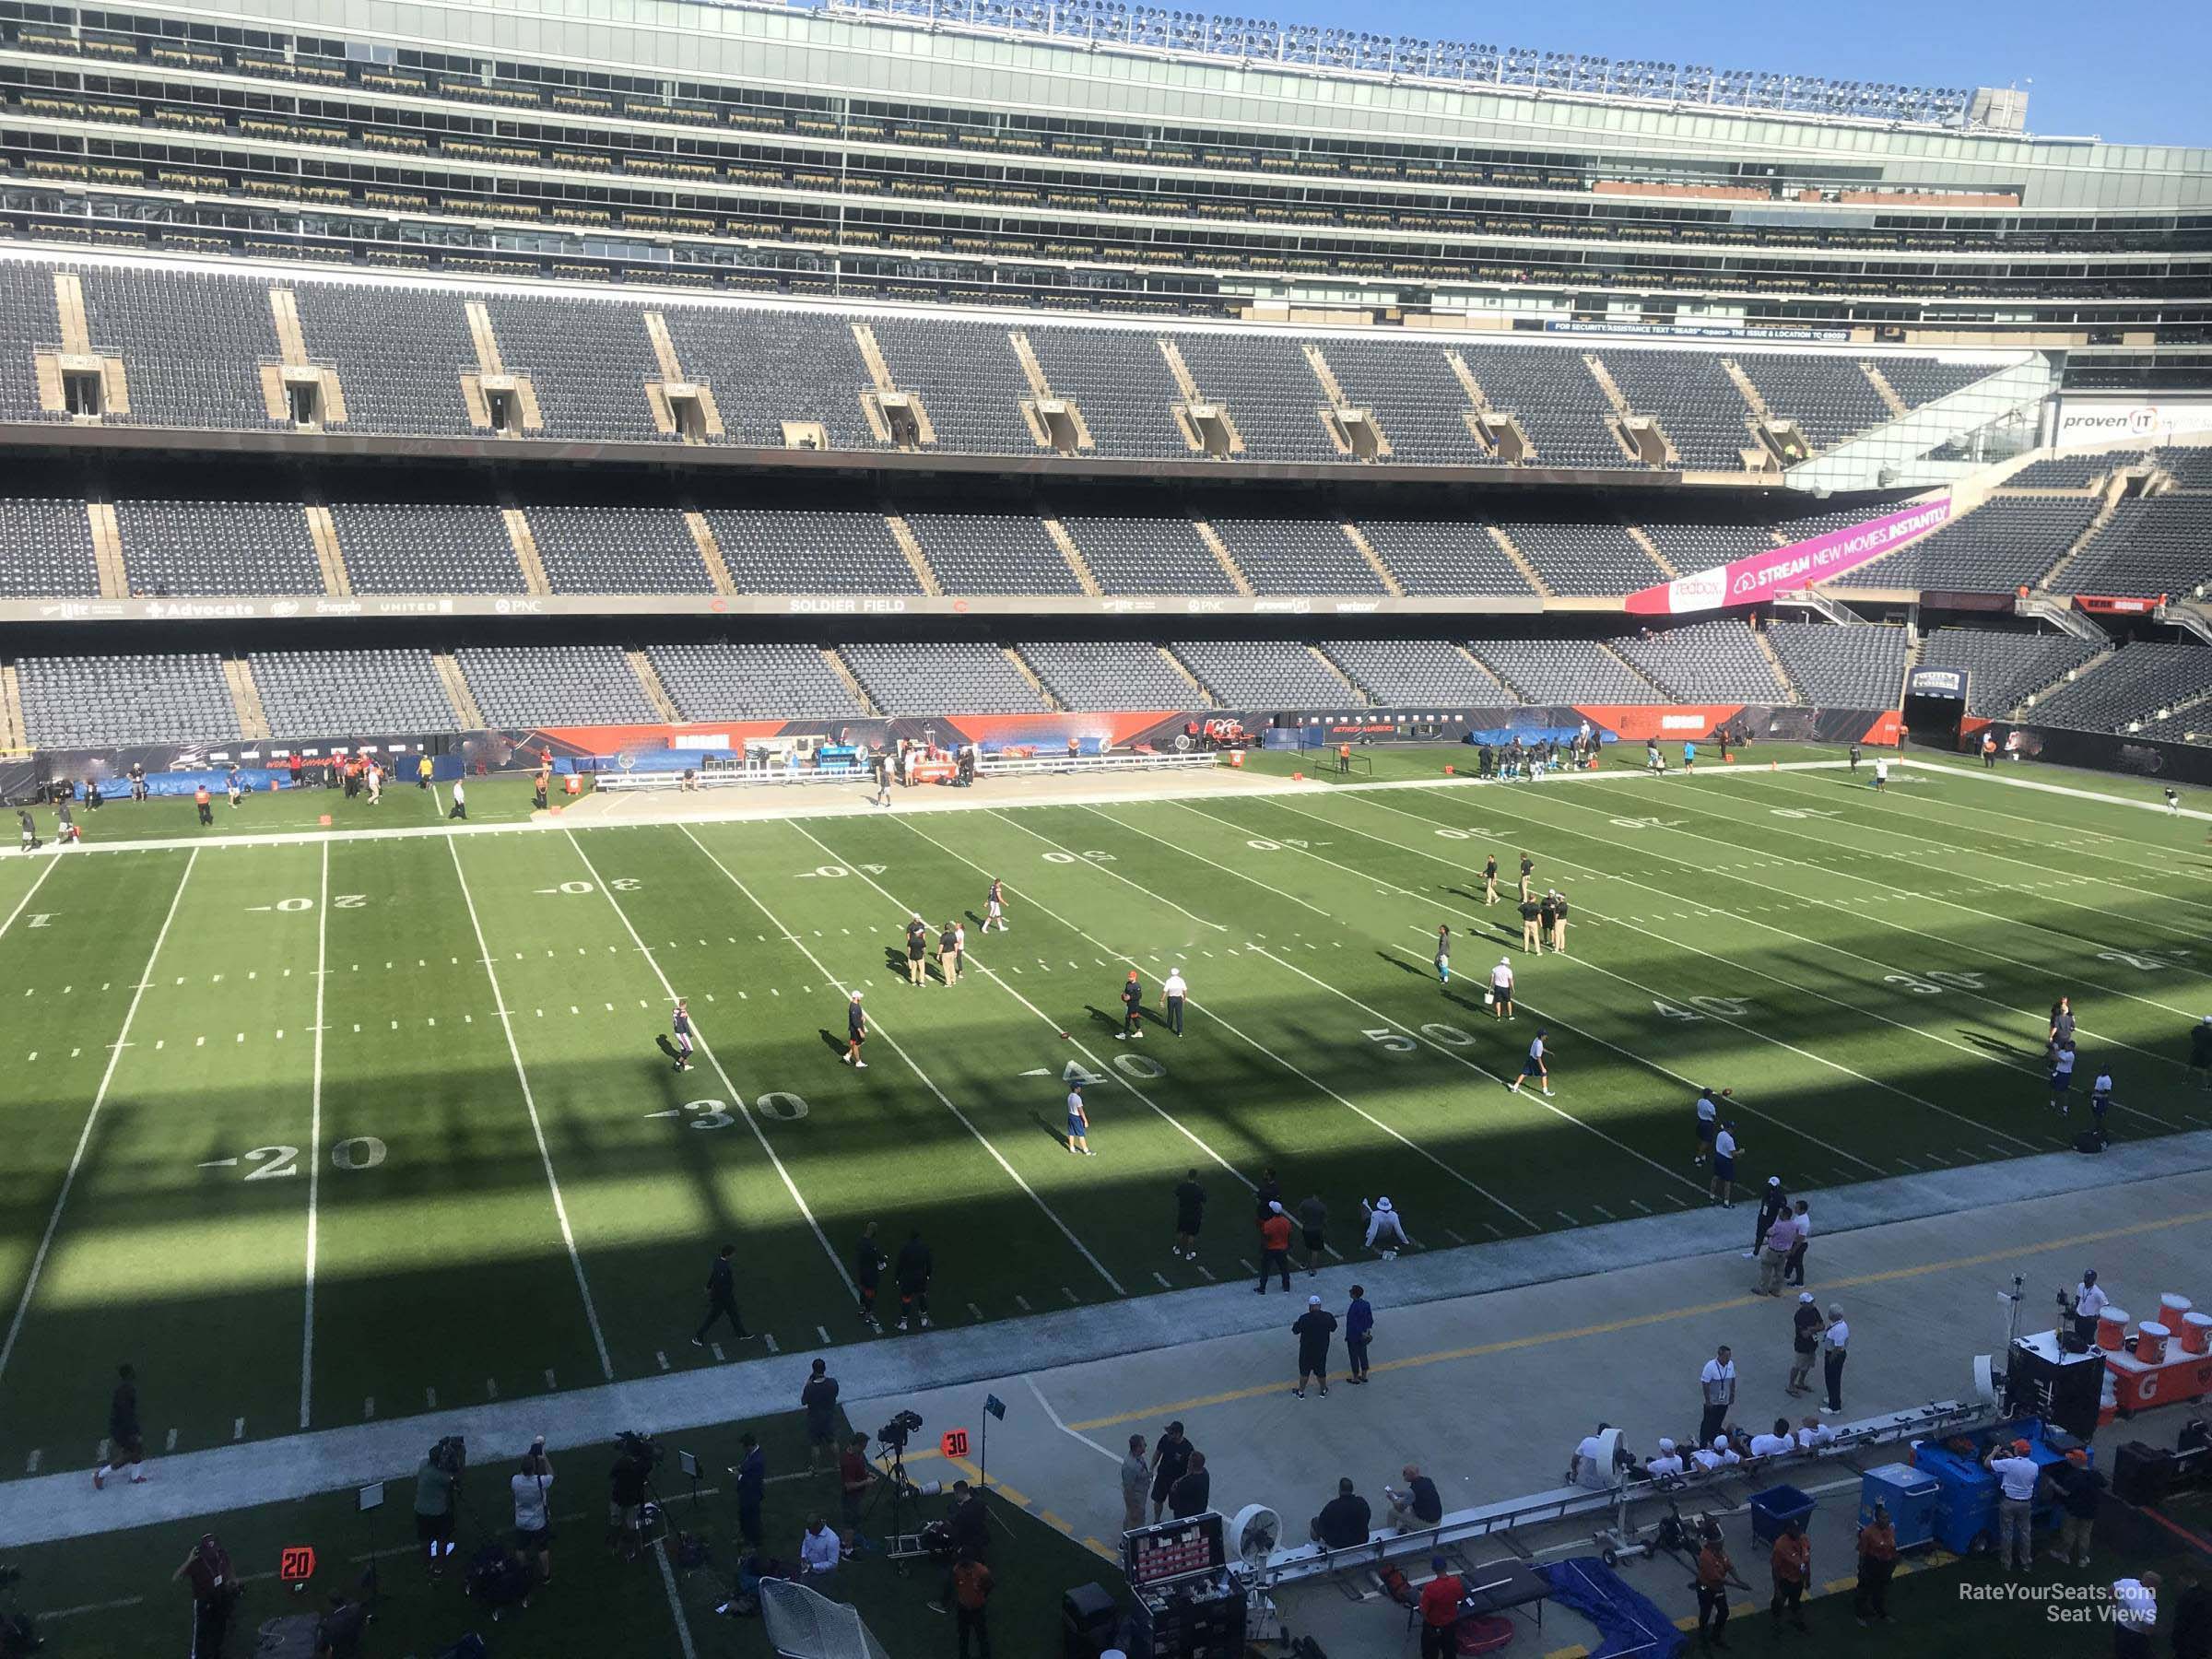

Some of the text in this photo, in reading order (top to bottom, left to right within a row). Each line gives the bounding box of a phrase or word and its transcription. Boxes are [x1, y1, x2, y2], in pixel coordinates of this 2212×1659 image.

[2064, 417, 2127, 429] proven
[2137, 416, 2151, 427] IT
[1758, 557, 1810, 585] STREAM
[1813, 544, 1842, 568] NEW
[1888, 505, 1947, 540] INSTANTLY
[166, 604, 254, 617] Advocate
[315, 601, 361, 615] Snapple
[380, 603, 436, 612] UNITED
[513, 601, 542, 612] PNC
[790, 600, 905, 612] SOLDIER FIELD
[1201, 601, 1224, 611] PNC
[1883, 971, 1986, 994] 30
[1653, 994, 1748, 1021] 40
[1361, 1022, 1476, 1053] 50
[1062, 1053, 1167, 1086] 40
[684, 1091, 809, 1130] 30
[243, 1135, 388, 1182] 20
[2138, 1371, 2159, 1400] G
[947, 1432, 968, 1455] 30
[284, 1552, 310, 1576] 20
